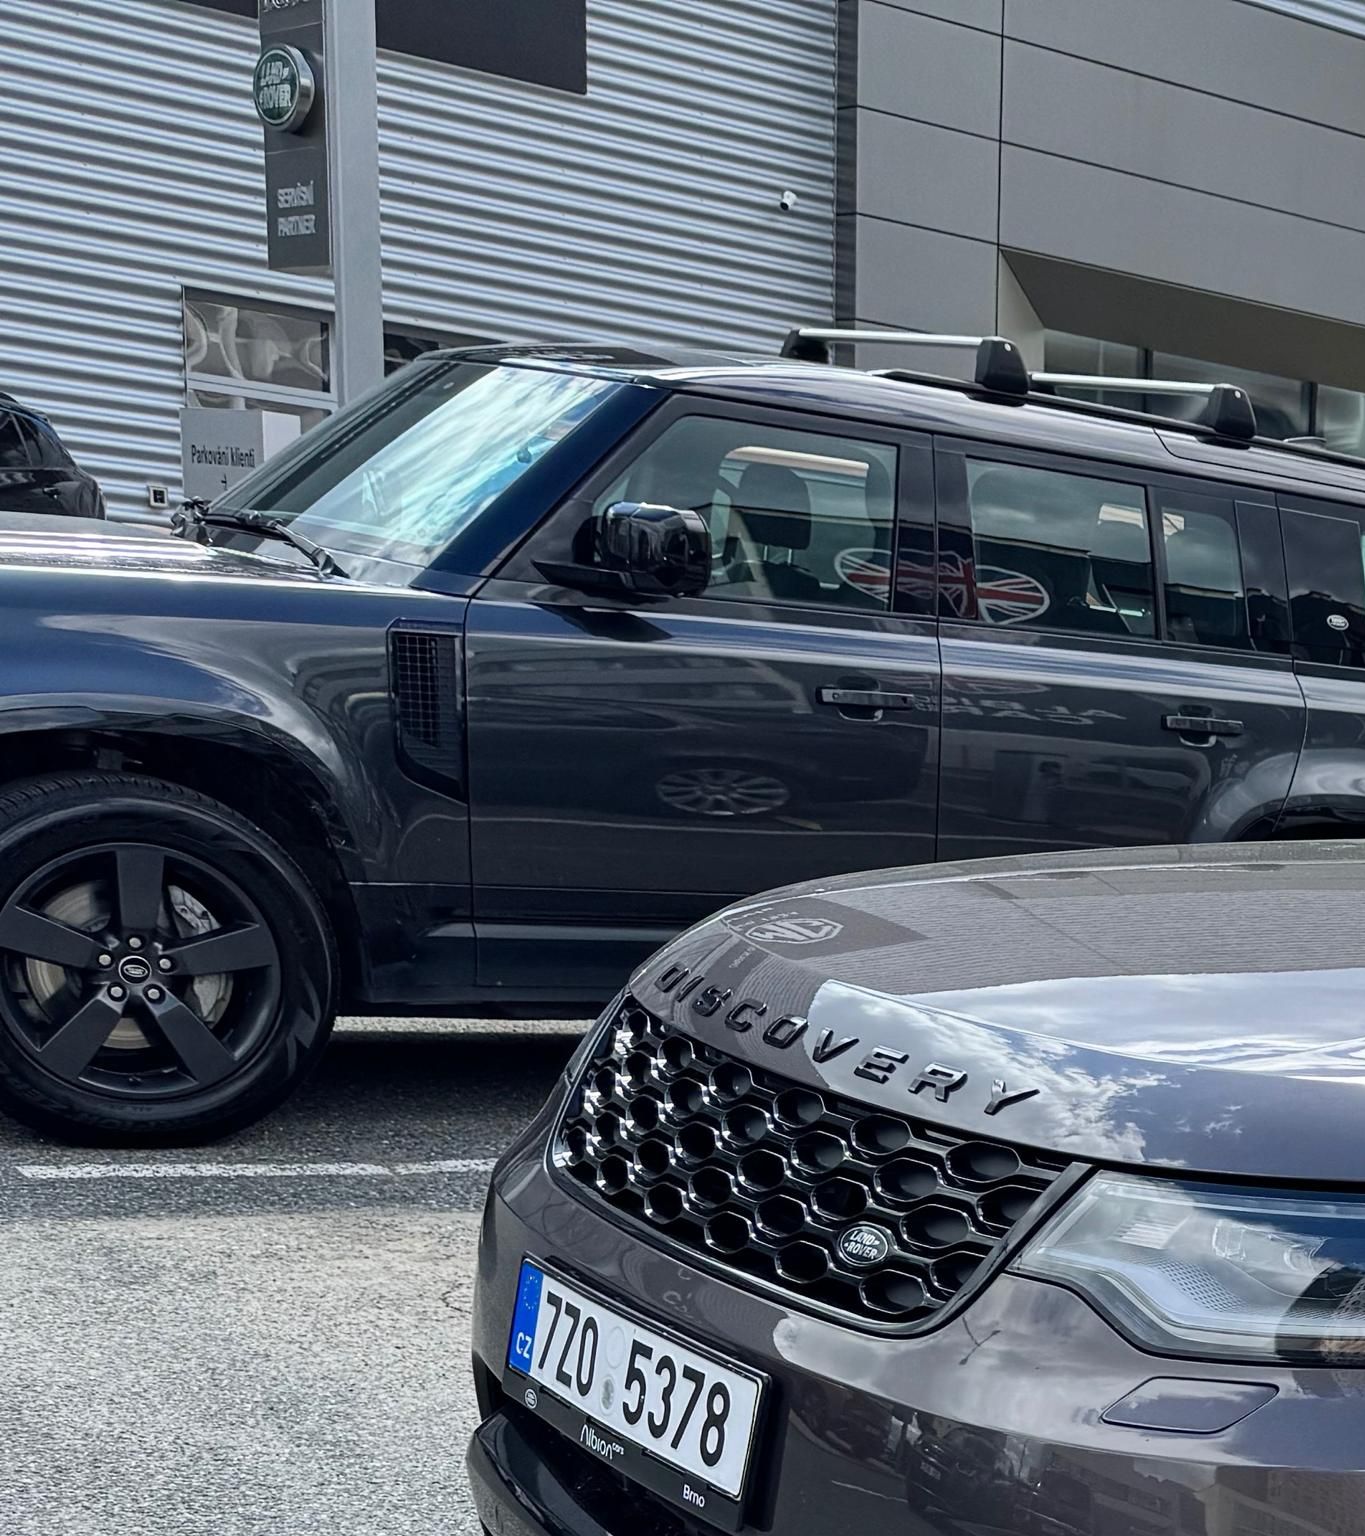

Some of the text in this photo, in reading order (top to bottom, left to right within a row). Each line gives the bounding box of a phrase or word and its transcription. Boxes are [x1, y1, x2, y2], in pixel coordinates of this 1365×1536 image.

[655, 961, 1041, 1117] DISCOVERY
[846, 1241, 878, 1260] ROVER
[850, 1230, 876, 1246] LAND
[516, 1331, 533, 1359] CZ
[622, 1338, 731, 1467] 5378
[683, 1484, 706, 1508] Brno
